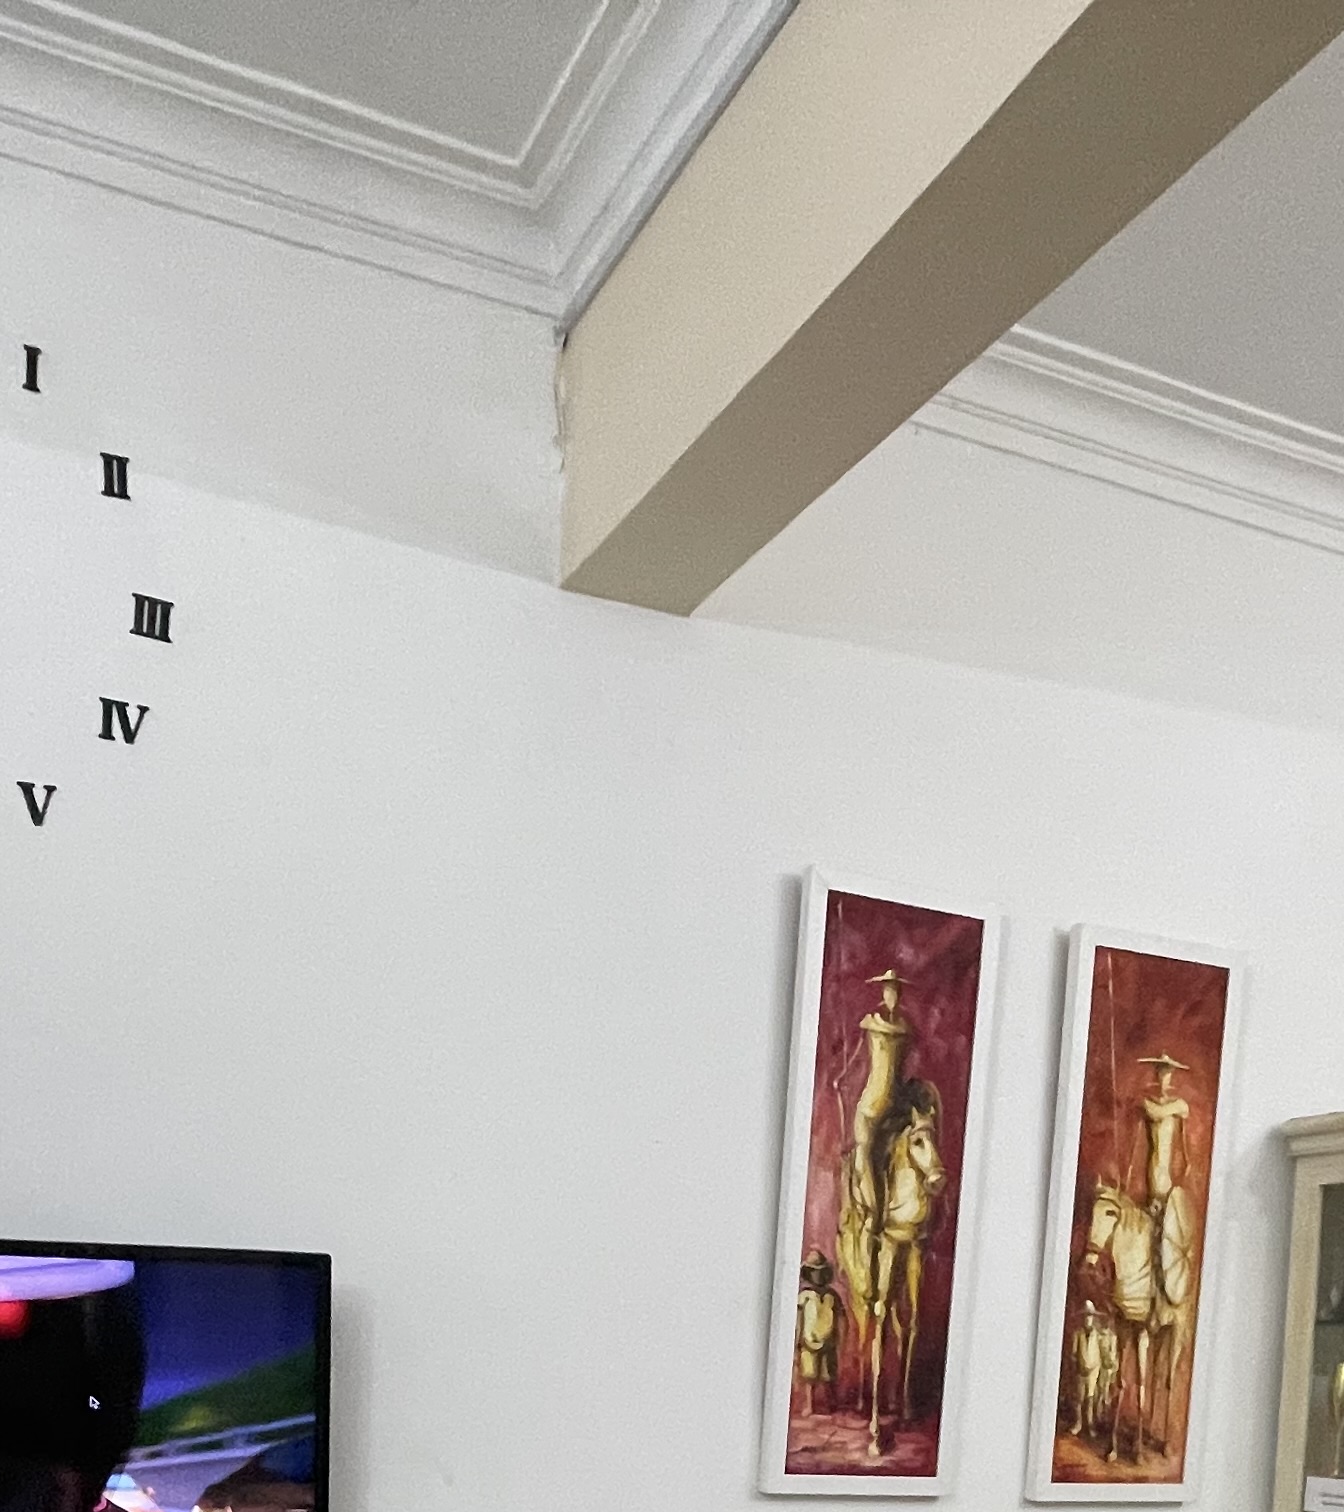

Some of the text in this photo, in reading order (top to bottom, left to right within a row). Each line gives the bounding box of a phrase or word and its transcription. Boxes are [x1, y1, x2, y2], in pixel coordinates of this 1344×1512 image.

[23, 344, 41, 393] I
[100, 453, 130, 500] II
[130, 593, 174, 643] III
[98, 697, 149, 744] IV
[17, 782, 57, 826] V
